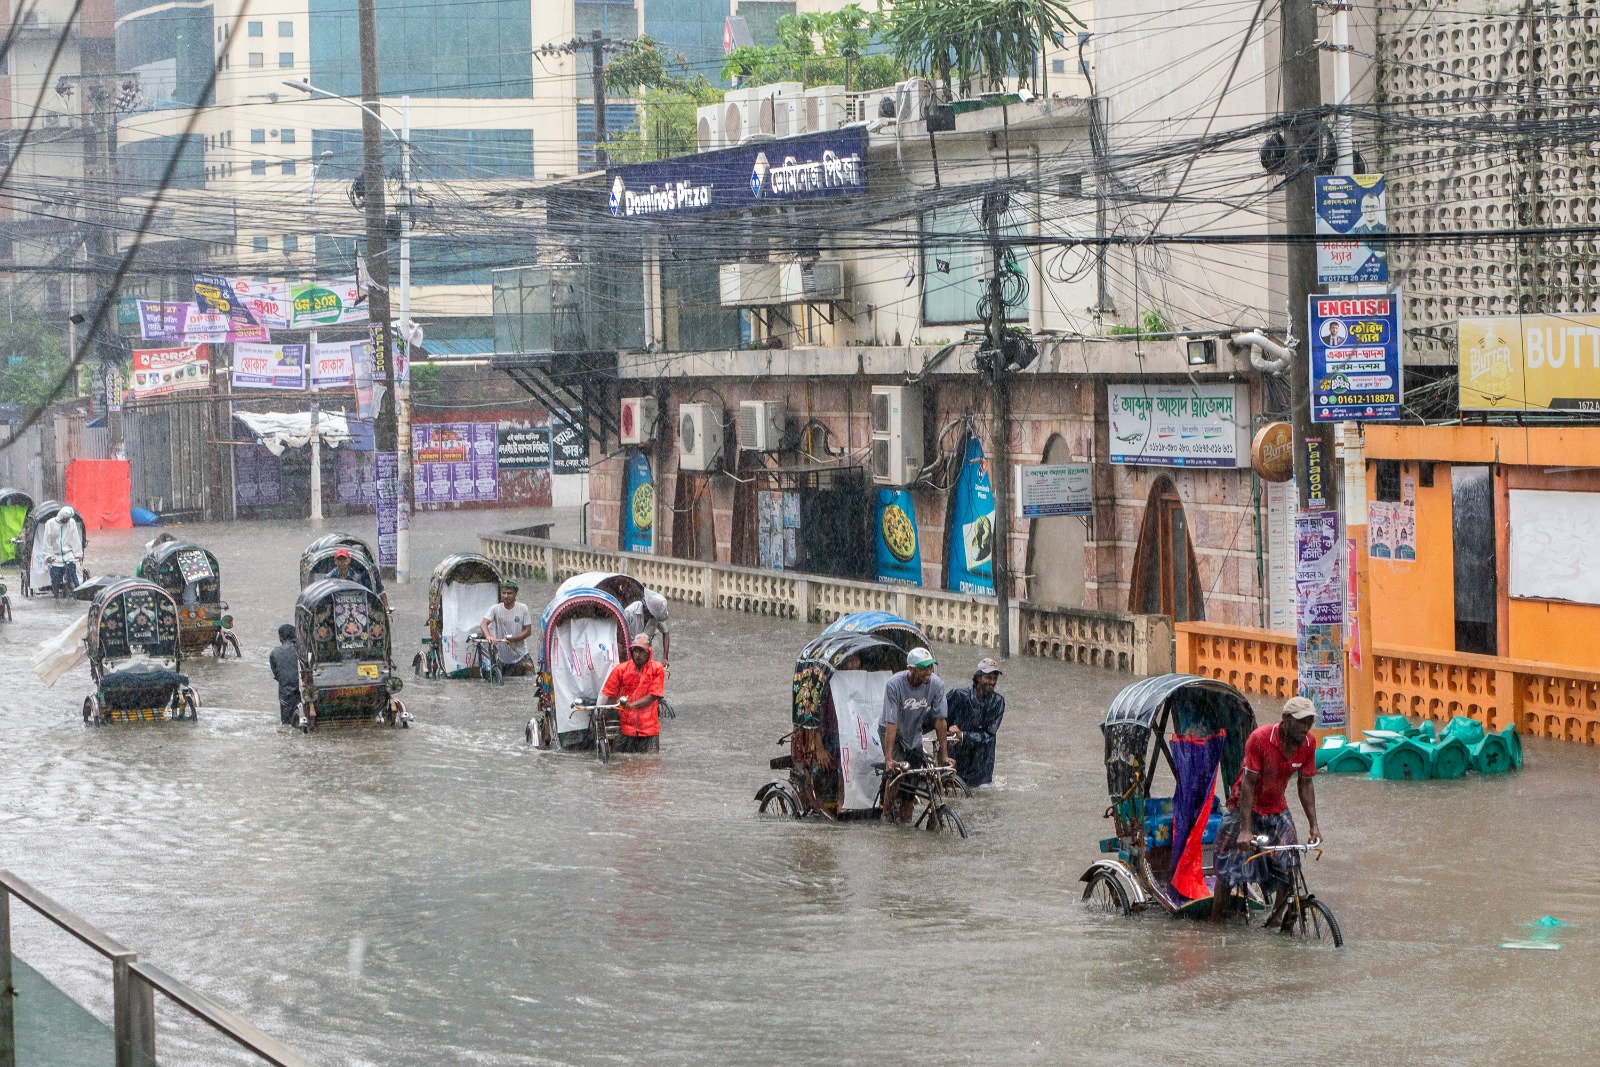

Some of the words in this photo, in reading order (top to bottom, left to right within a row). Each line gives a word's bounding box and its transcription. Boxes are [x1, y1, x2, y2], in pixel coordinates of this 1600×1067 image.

[625, 182, 675, 216] Domino's
[676, 180, 713, 209] Pizza
[1331, 251, 1352, 265] স্যার
[1319, 299, 1389, 317] ENGLISH
[1349, 321, 1383, 335] তৌহিদ
[1327, 350, 1384, 359] একাদশ-দ্বাদশ
[241, 356, 268, 374] ফোকাস
[318, 357, 345, 375] ফোকাস
[1470, 346, 1514, 382] BUTTER
[1338, 394, 1395, 404] 01612-118878
[1578, 401, 1594, 409] 1672
[1120, 397, 1154, 420] আব্দুল
[1156, 397, 1188, 417] আহাদ
[1308, 442, 1322, 499] Paragon
[1298, 571, 1316, 579] ডাবল
